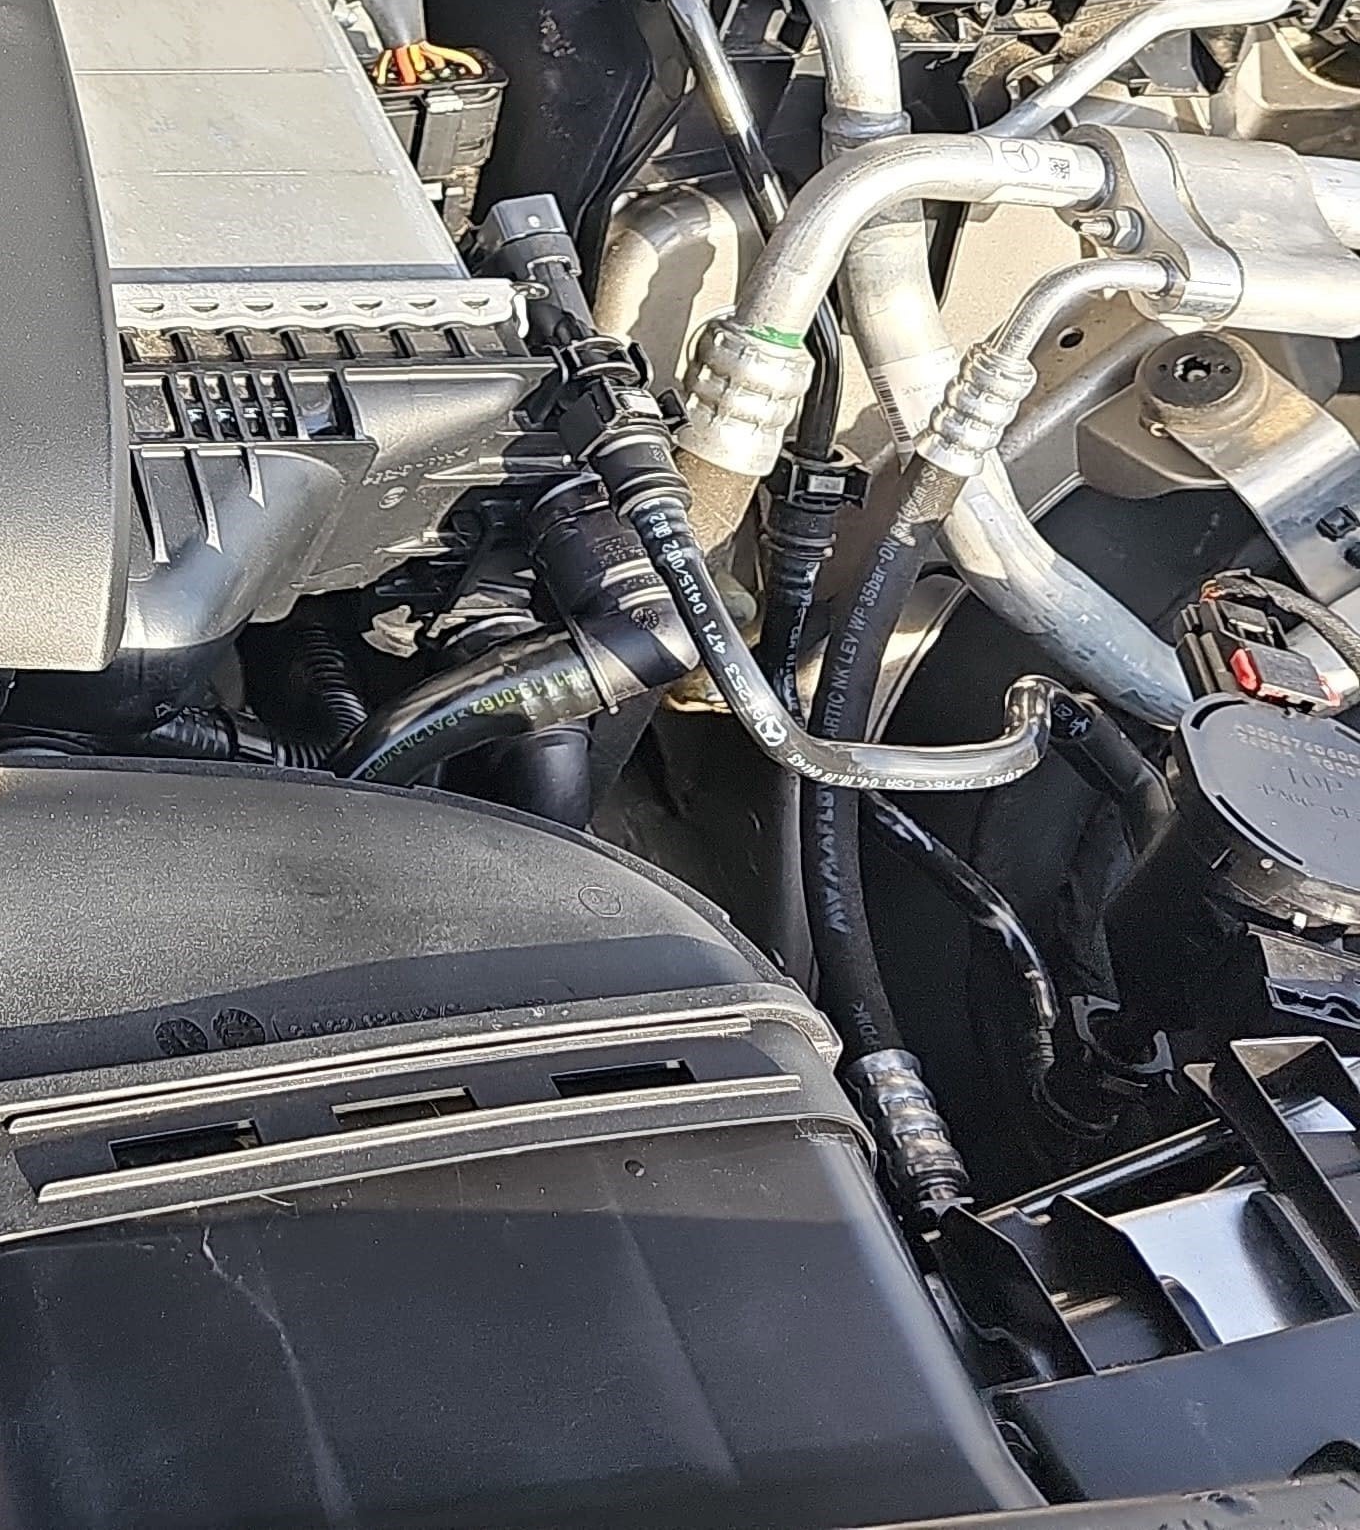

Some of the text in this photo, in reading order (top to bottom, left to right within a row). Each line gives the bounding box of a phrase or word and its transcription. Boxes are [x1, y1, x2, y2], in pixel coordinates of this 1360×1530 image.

[661, 539, 708, 616] 0415/002
[859, 565, 887, 607] 35bar
[848, 605, 867, 631] WP
[701, 620, 726, 656] 471
[839, 633, 861, 664] LEV
